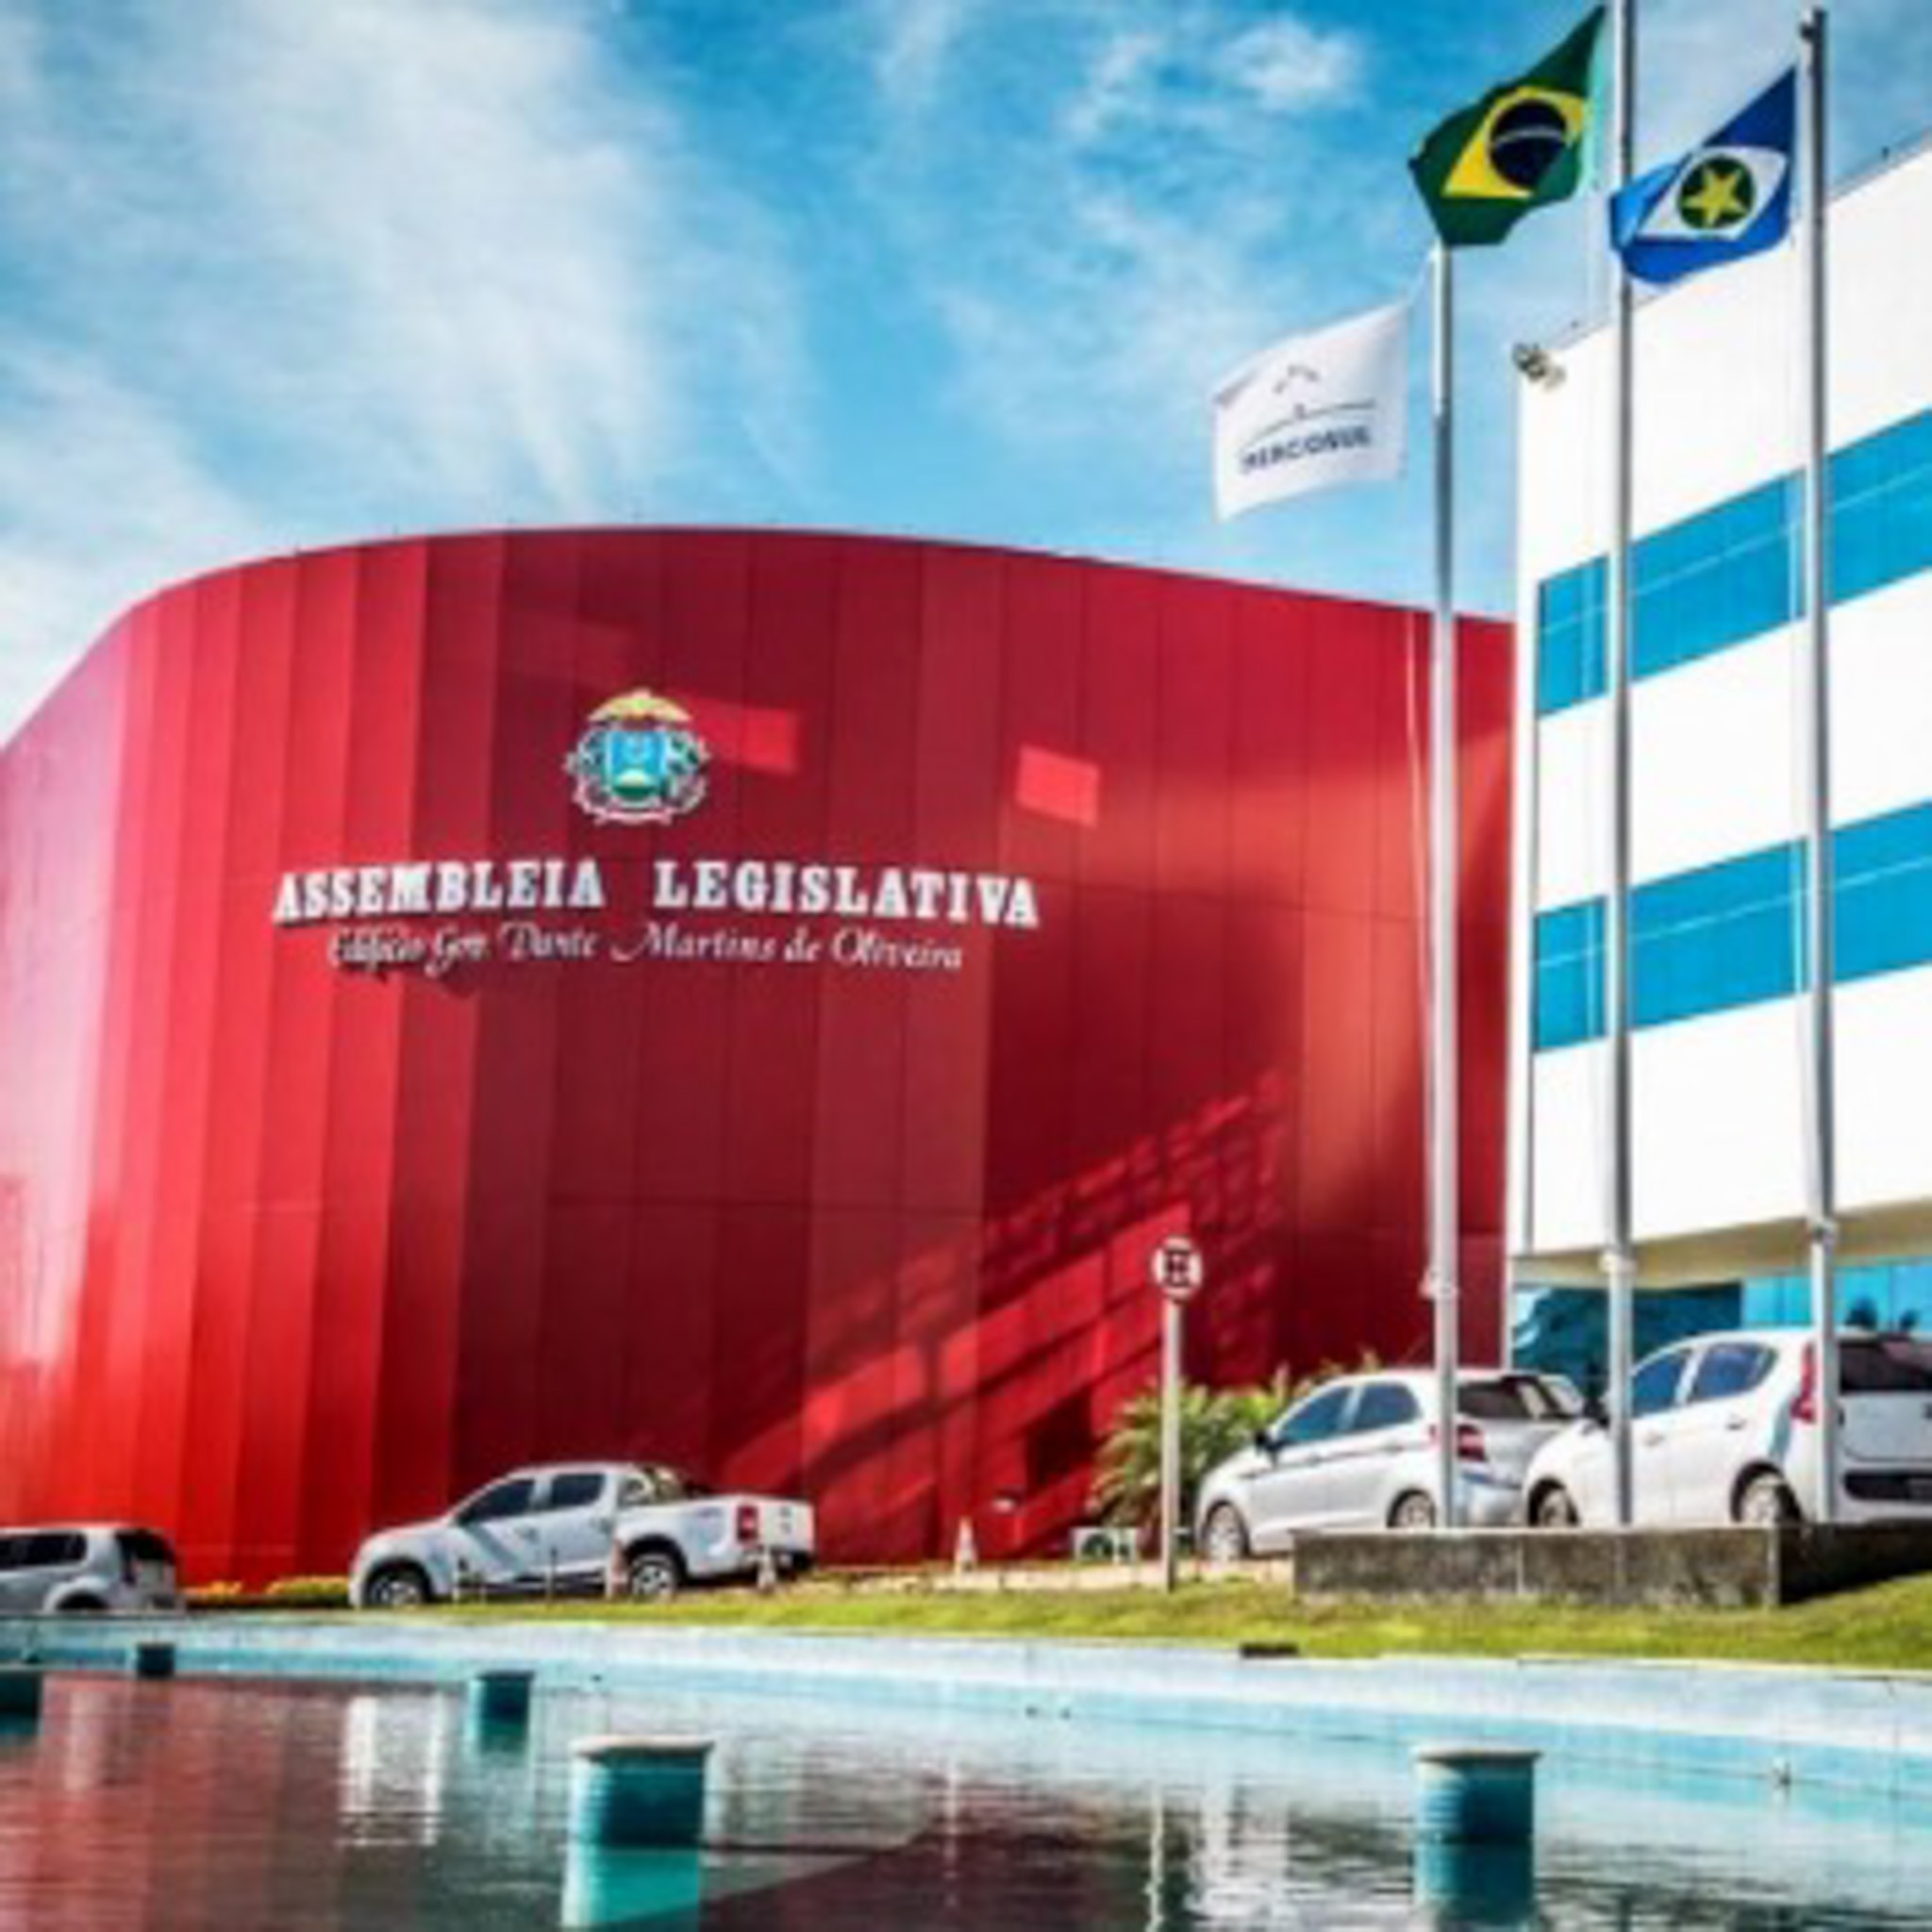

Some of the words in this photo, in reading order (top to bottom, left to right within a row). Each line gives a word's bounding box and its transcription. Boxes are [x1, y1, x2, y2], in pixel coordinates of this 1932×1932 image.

[273, 858, 605, 924] ASSEMBLEIA
[655, 860, 1039, 927] LEGISLATIVA
[610, 921, 774, 962] Martins
[784, 927, 821, 962] de
[831, 926, 963, 970] Oliveira
